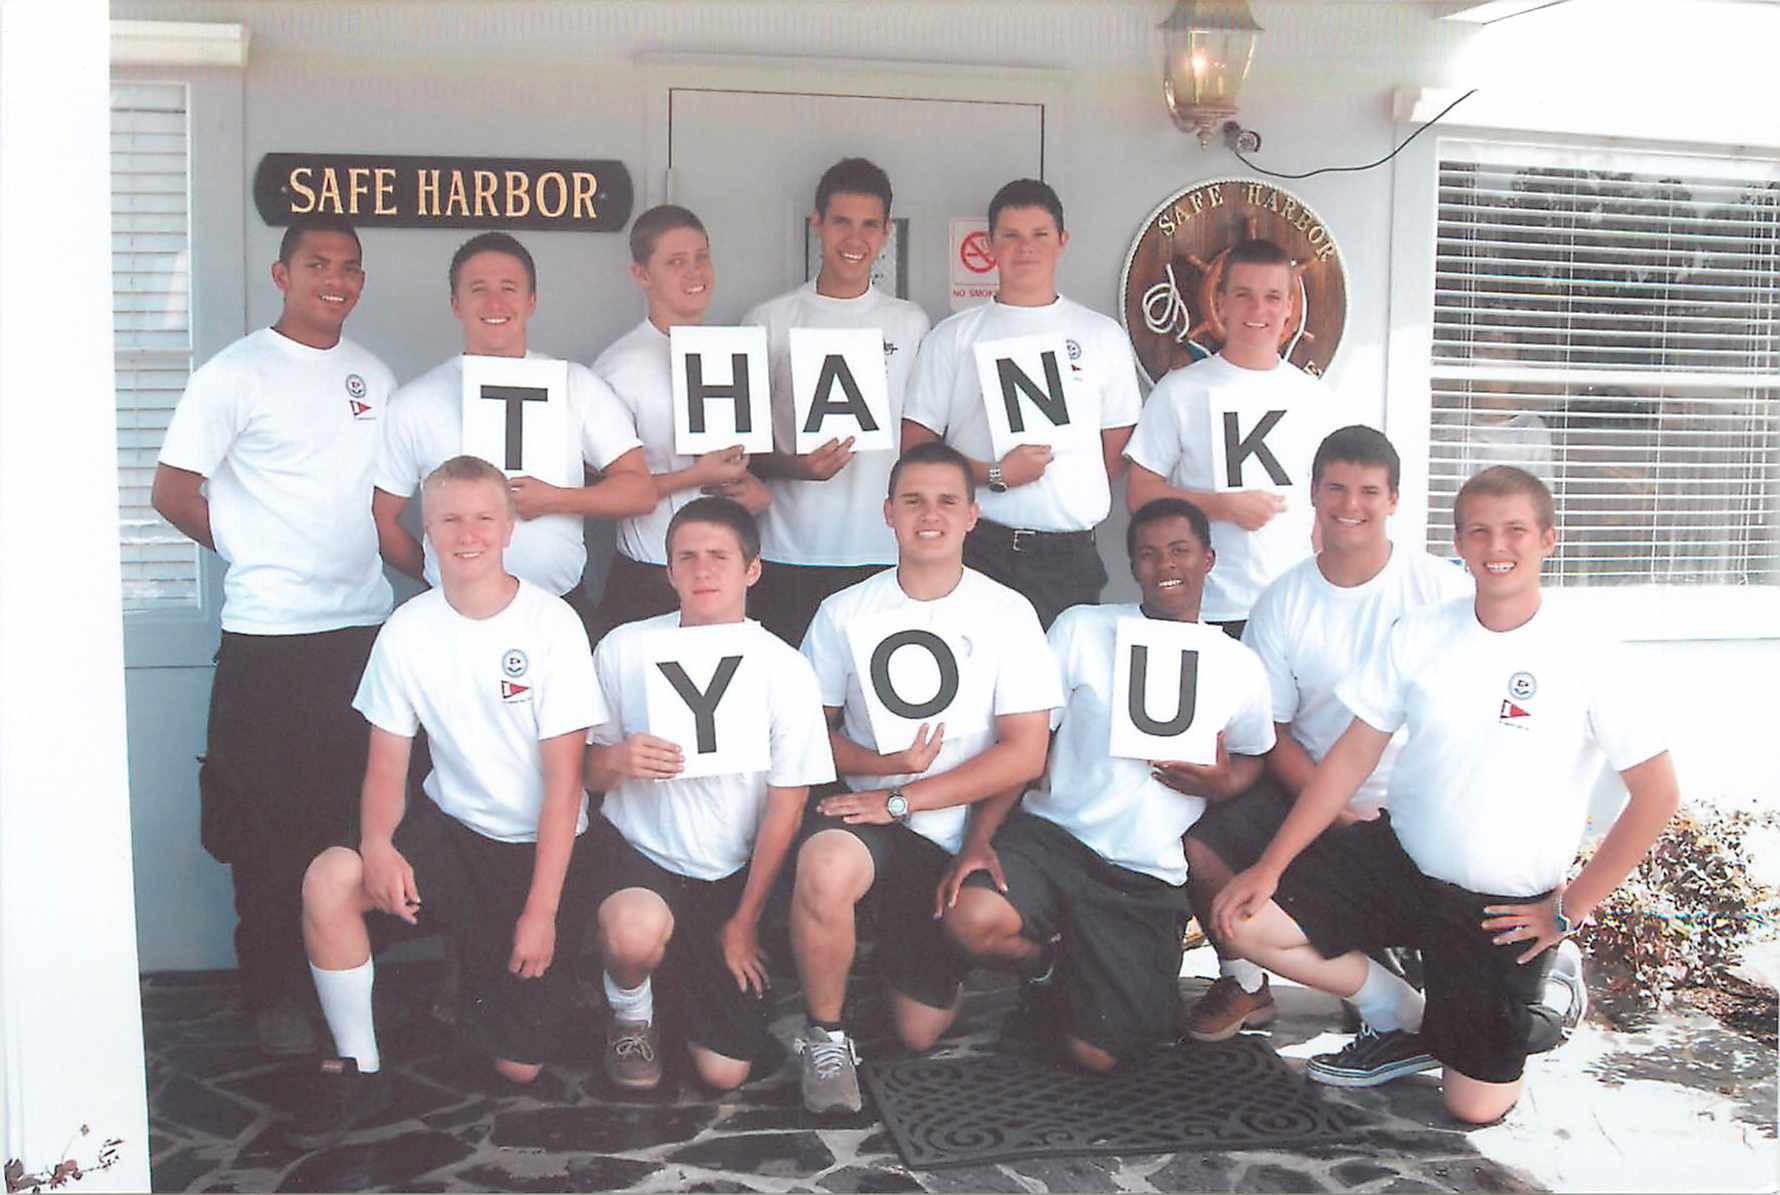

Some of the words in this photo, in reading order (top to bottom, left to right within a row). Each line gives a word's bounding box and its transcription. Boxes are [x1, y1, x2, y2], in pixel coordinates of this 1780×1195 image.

[289, 167, 398, 216] SAFE
[416, 168, 599, 219] HARBOR
[1158, 184, 1224, 236] SAFE
[1246, 184, 1335, 263] HARBOR
[953, 289, 966, 297] NO
[969, 289, 993, 298] SMOK
